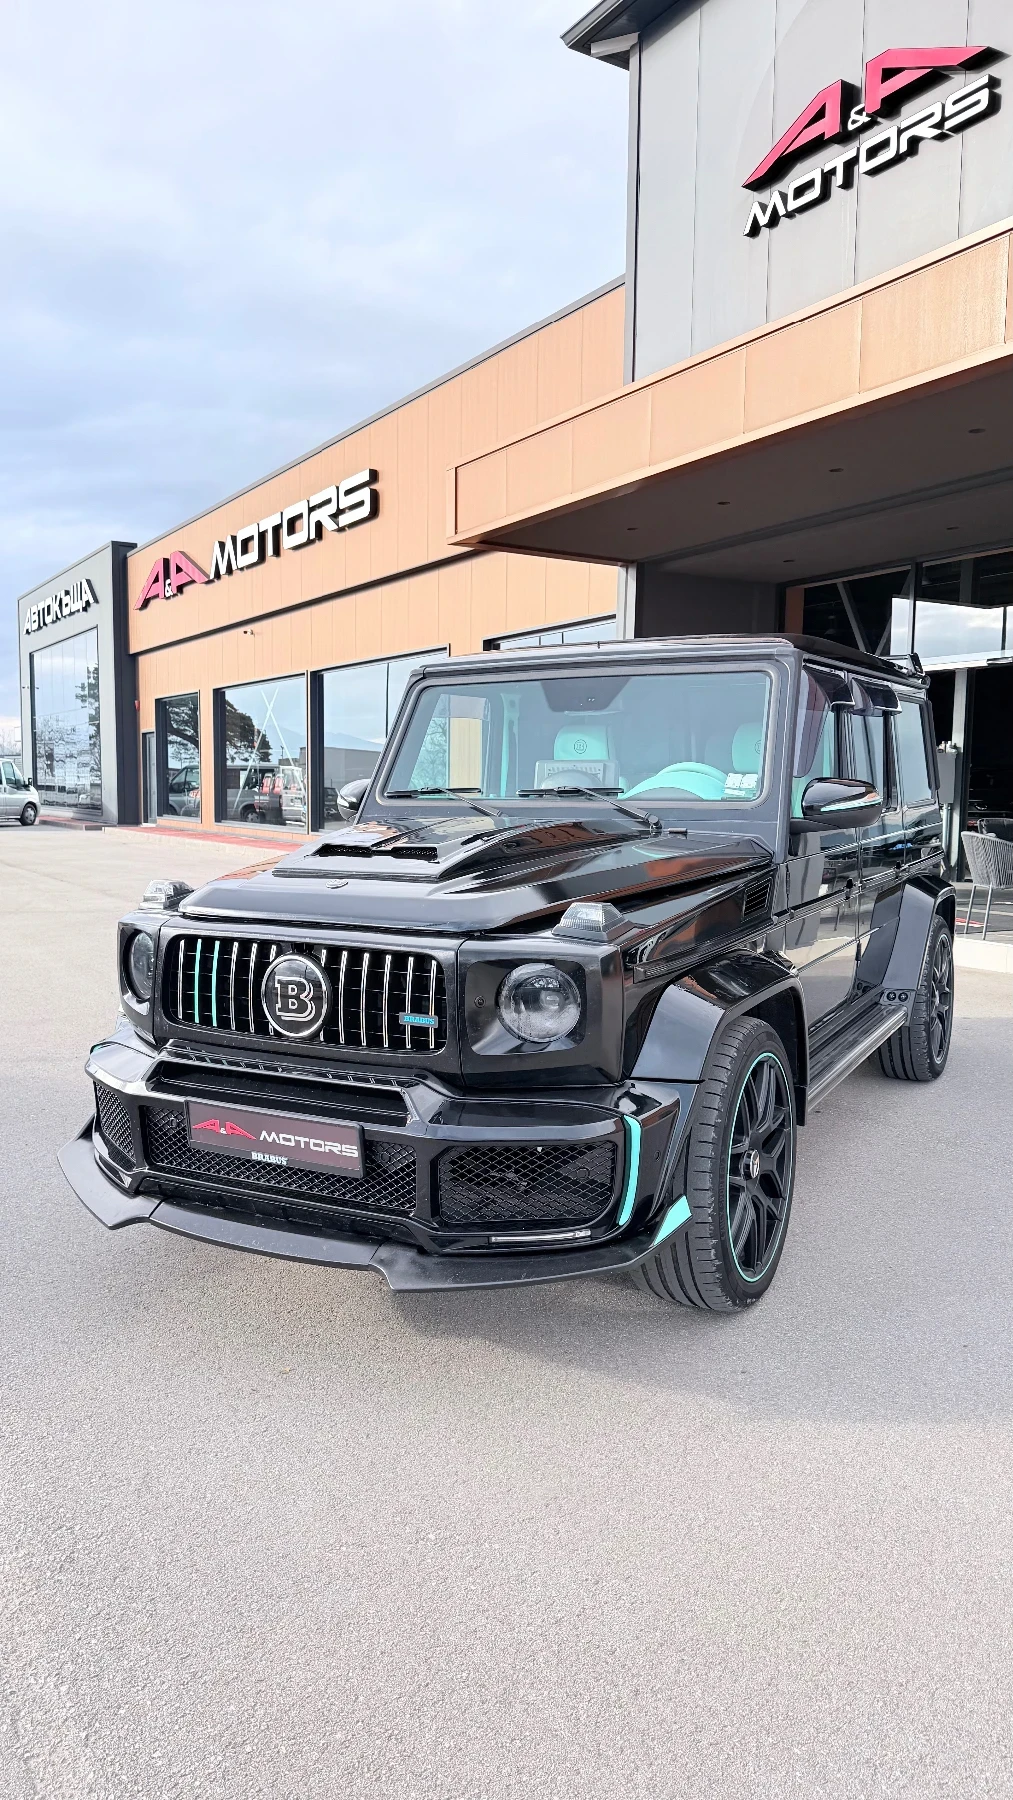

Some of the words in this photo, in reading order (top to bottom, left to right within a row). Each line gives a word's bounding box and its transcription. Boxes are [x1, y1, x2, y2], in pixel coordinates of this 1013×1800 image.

[743, 74, 991, 237] MOTORS
[134, 550, 210, 610] A&A
[210, 468, 374, 580] MOTORS
[23, 578, 95, 635] АВТОКЪЩА
[275, 975, 316, 1021] B
[403, 1015, 435, 1025] BRABUS
[192, 1118, 257, 1140] A&A
[259, 1130, 359, 1158] MOTORS
[251, 1151, 288, 1165] BRABUS
